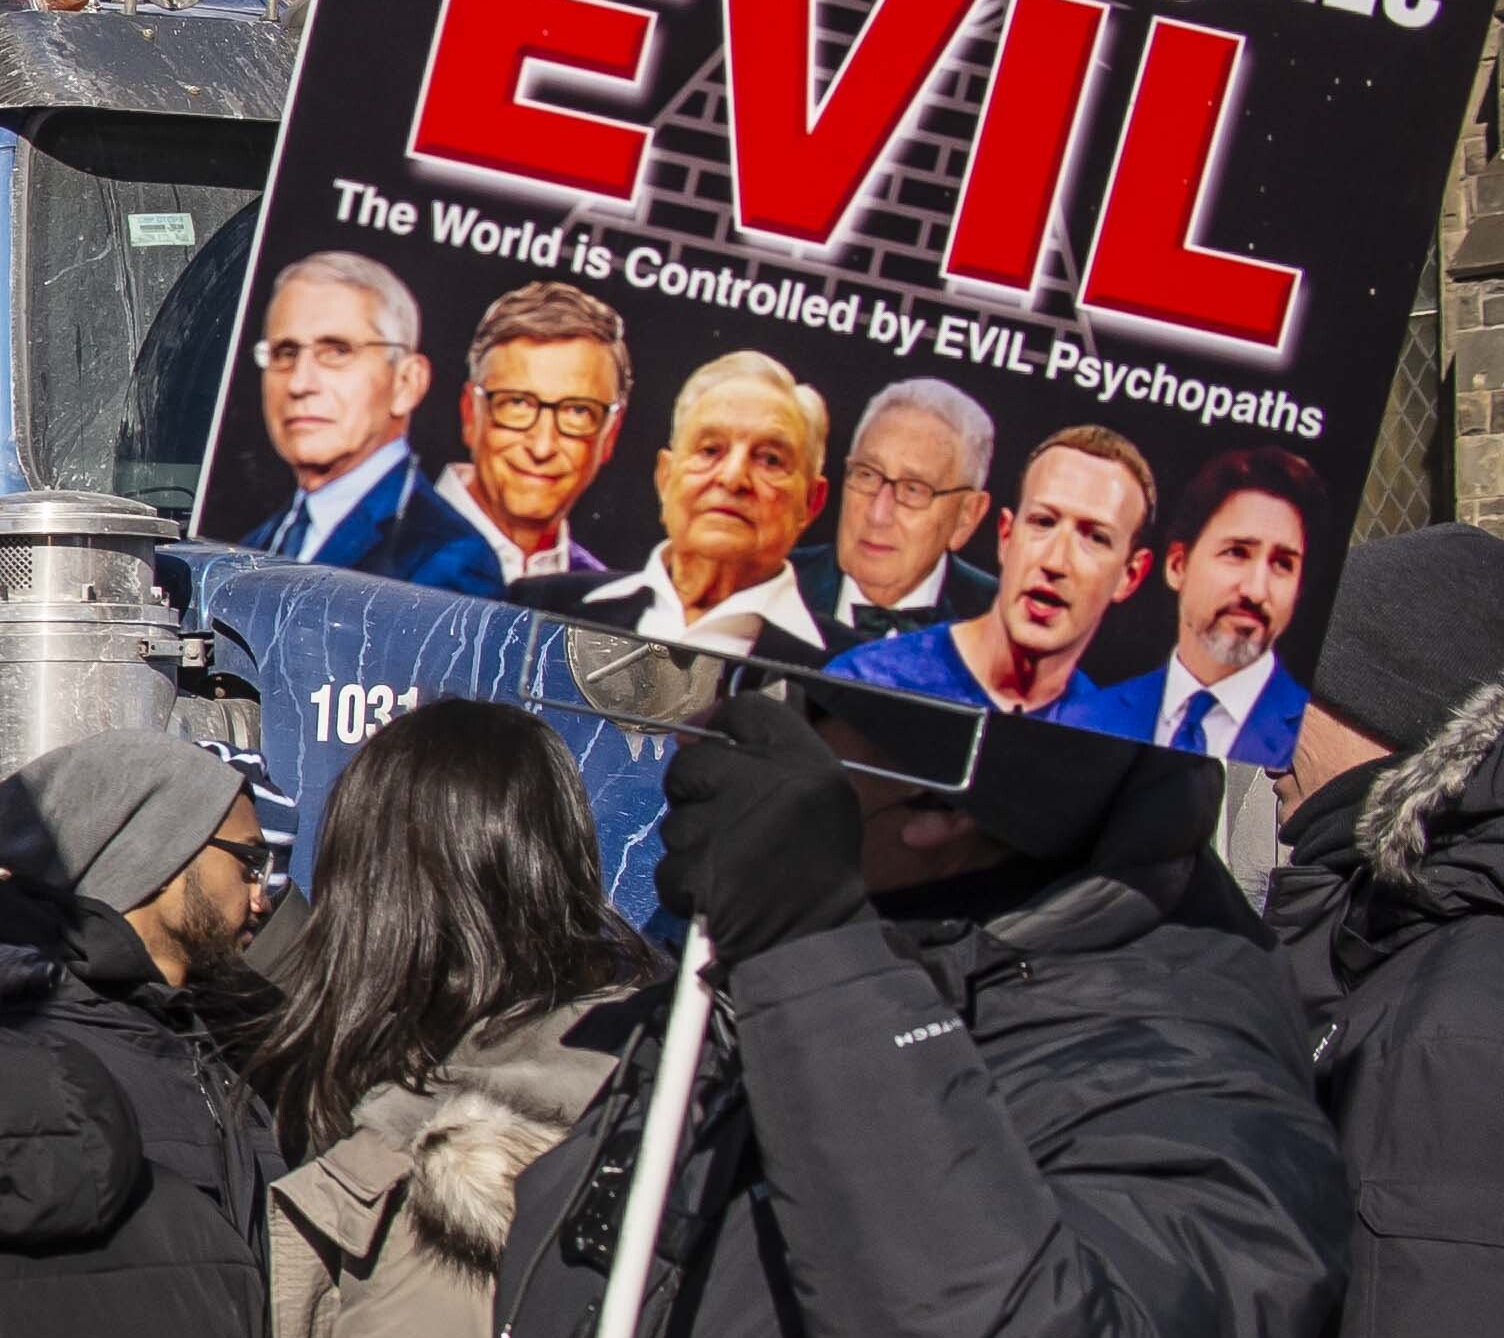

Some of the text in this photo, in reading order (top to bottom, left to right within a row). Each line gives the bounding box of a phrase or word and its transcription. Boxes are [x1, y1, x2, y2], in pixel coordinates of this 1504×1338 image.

[333, 178, 1326, 440] The World is Controlled by EVIL Psychopaths
